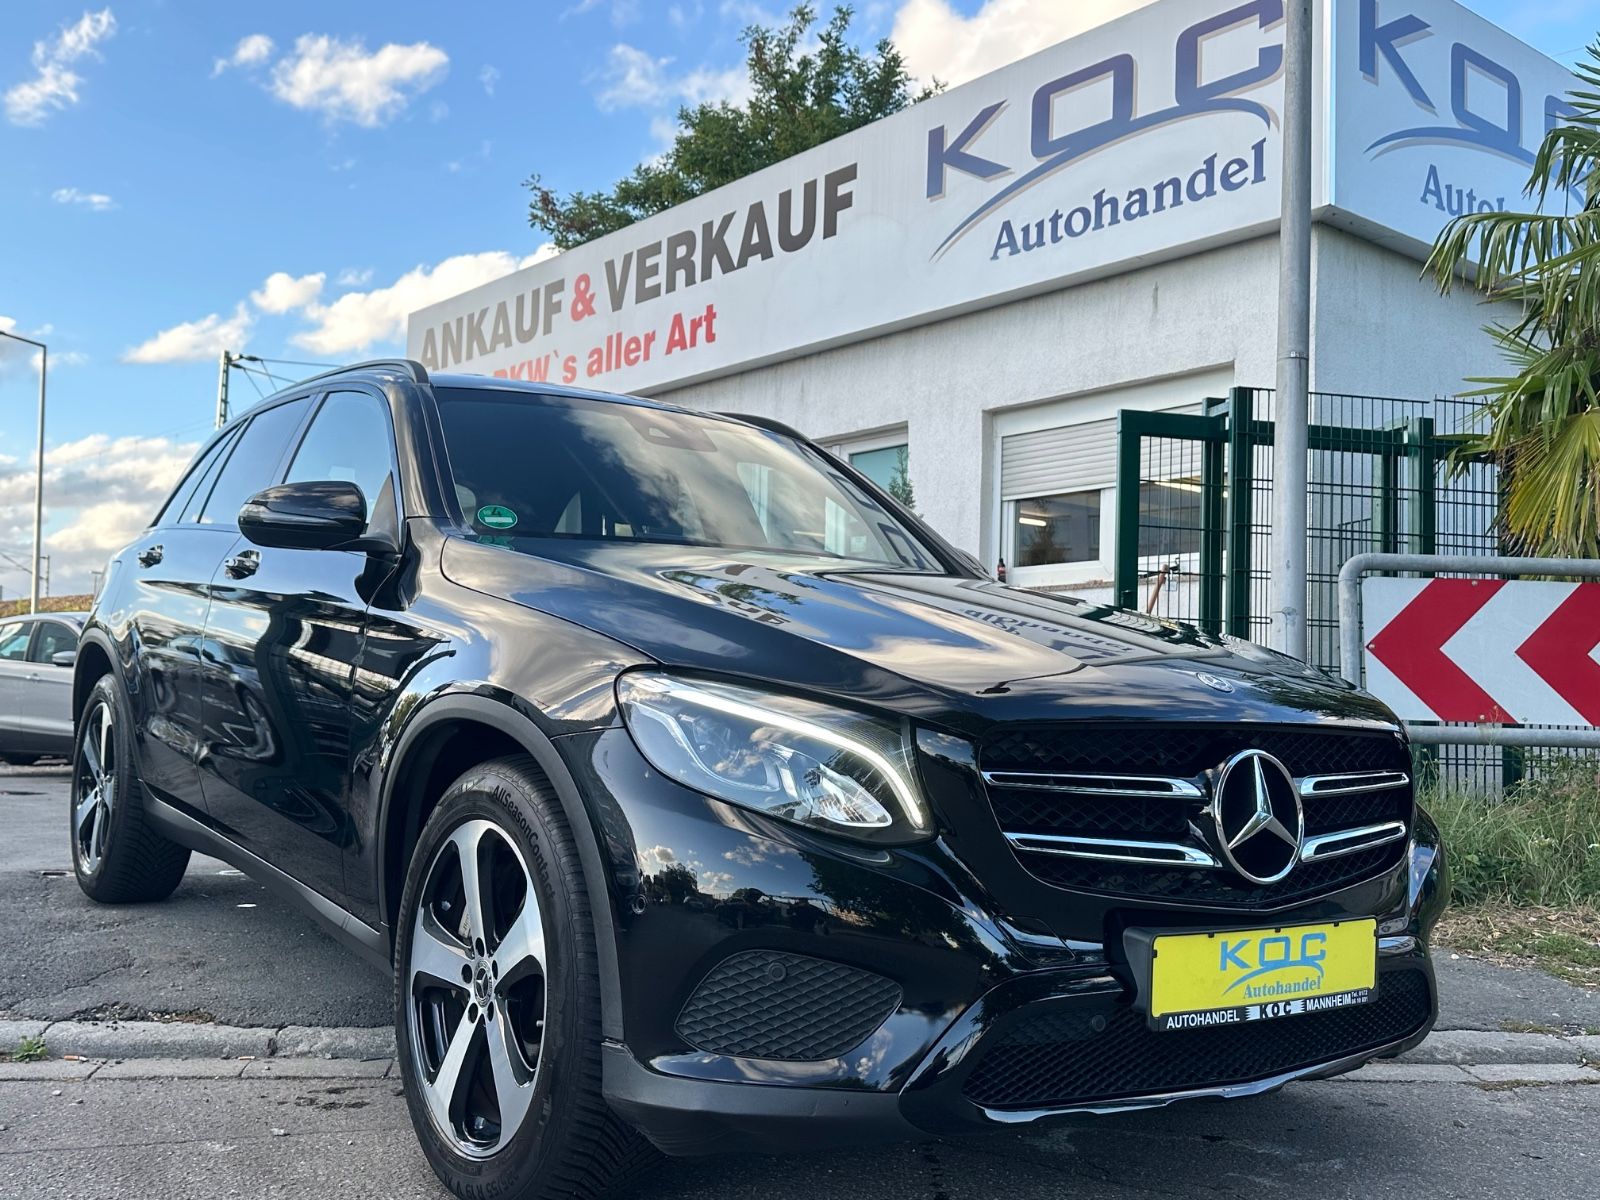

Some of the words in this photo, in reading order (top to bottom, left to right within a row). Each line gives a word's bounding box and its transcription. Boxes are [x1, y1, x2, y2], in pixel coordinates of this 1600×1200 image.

[926, 0, 1285, 200] KOC
[990, 137, 1266, 260] Autohandel
[421, 278, 565, 372] ANKAUF
[570, 273, 596, 322] &
[604, 162, 858, 313] VERKAUF
[587, 329, 655, 378] aller
[665, 304, 716, 357] Art
[492, 784, 557, 898] AllSeasonContact
[1219, 932, 1327, 971] KOC
[1243, 976, 1321, 999] Autohandel
[1166, 1009, 1240, 1029] AUTOHANDEL
[1306, 994, 1351, 1011] MANNHEIM
